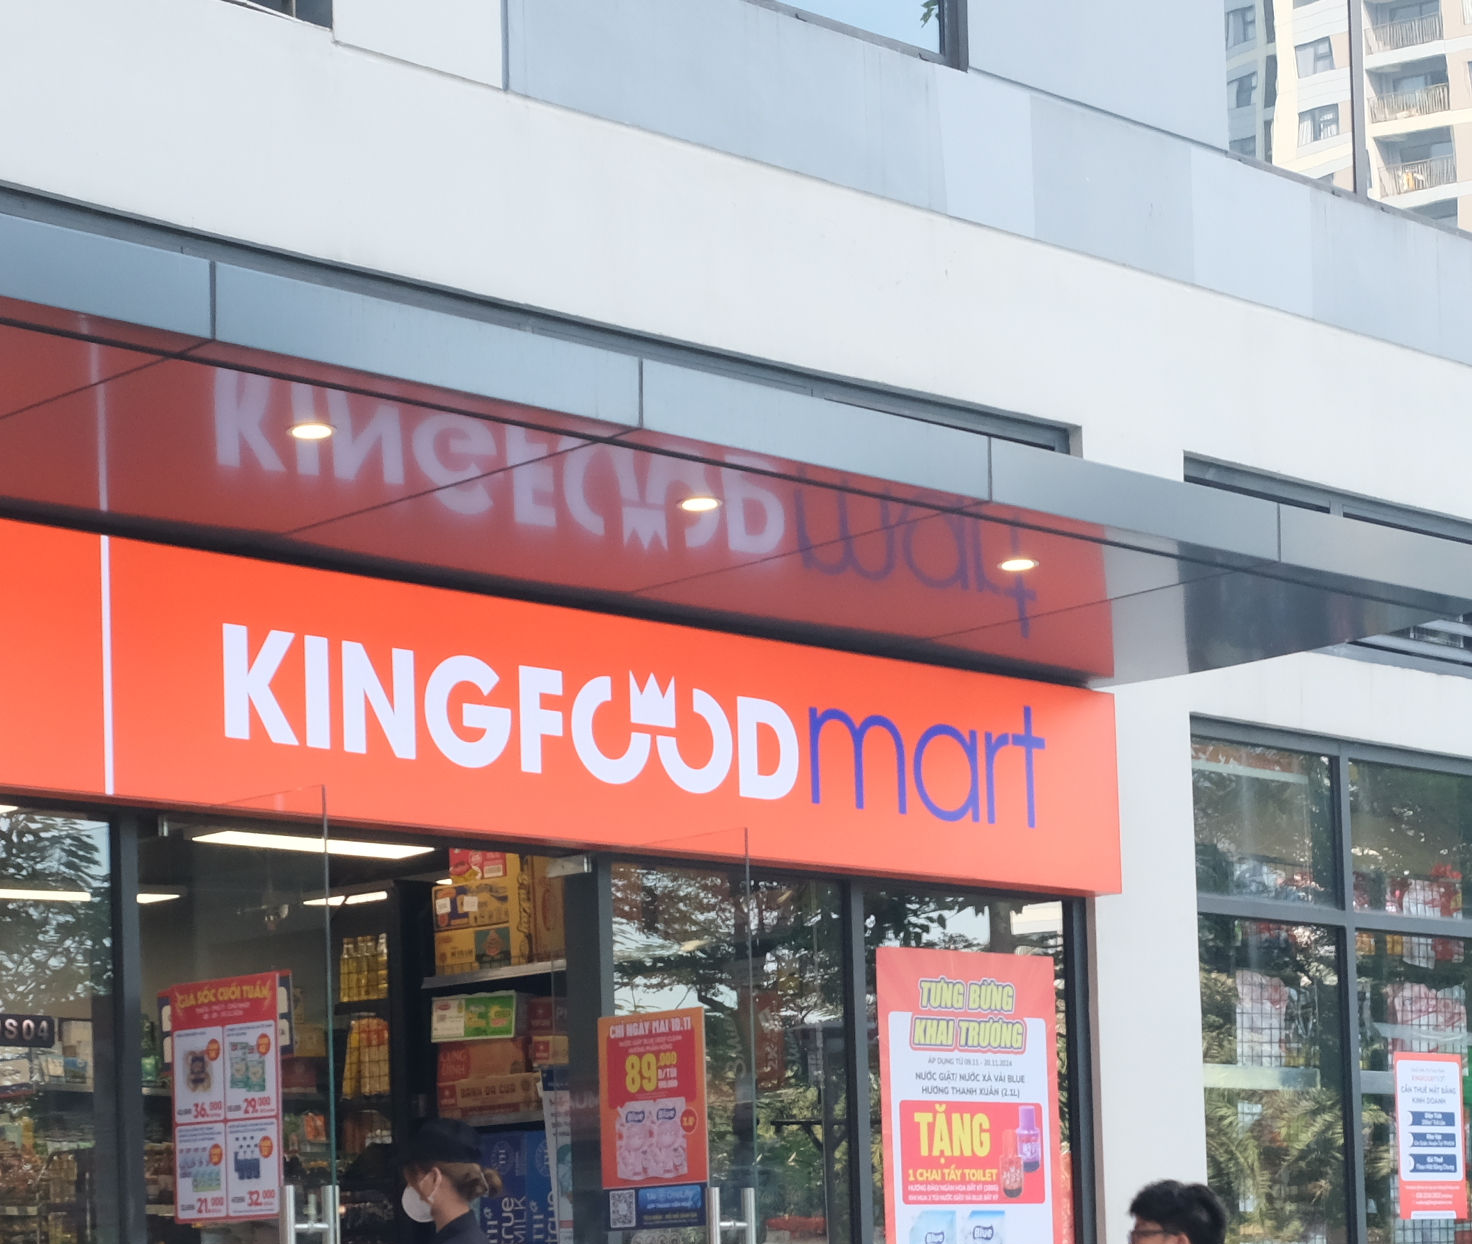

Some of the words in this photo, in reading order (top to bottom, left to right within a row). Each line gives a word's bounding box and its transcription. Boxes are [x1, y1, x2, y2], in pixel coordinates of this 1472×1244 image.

[919, 977, 966, 1010] TƯNG
[652, 1019, 669, 1034] MAI
[913, 1017, 955, 1047] KHAI
[958, 1017, 1024, 1050] TRƯƠNG
[916, 1071, 937, 1080] NƯỚC
[959, 1071, 979, 1081] NƯỚC
[1007, 1075, 1025, 1083] BLUE
[922, 1086, 949, 1095] HƯƠNG
[951, 1087, 977, 1095] THANH
[979, 1086, 999, 1096] XUÂN
[914, 1104, 991, 1164] TẶNG
[908, 1169, 914, 1181] 1
[916, 1169, 942, 1181] CHAI
[964, 1169, 998, 1181] TOILET
